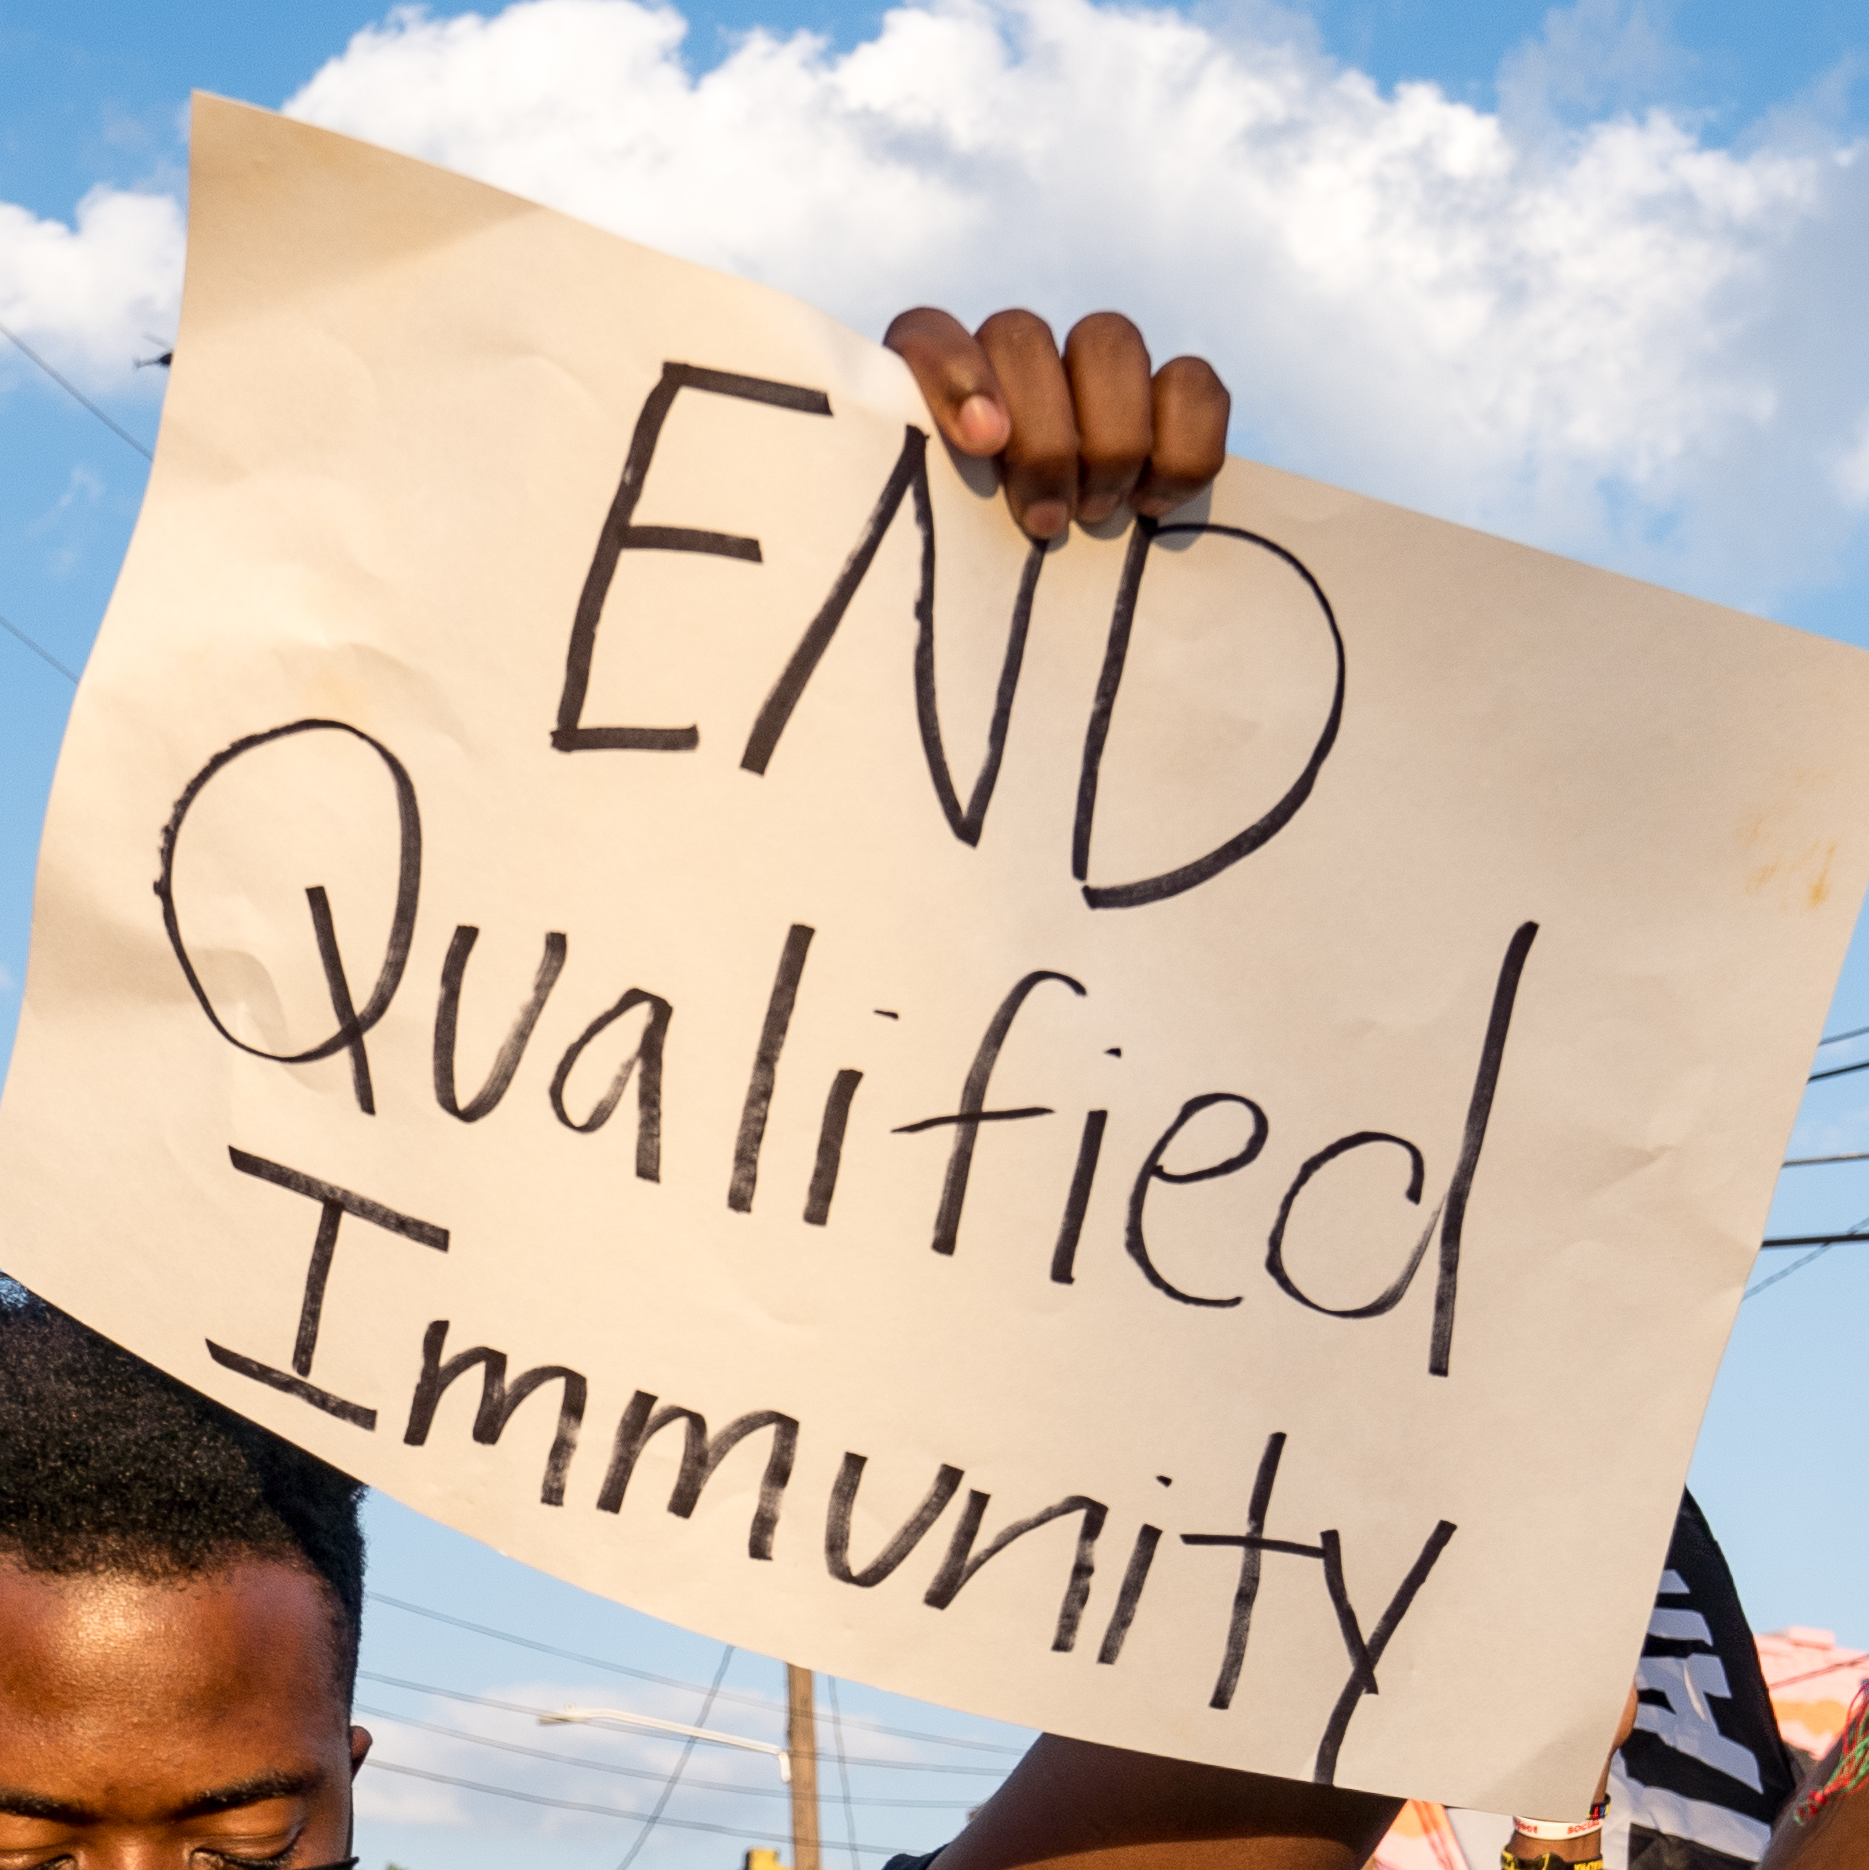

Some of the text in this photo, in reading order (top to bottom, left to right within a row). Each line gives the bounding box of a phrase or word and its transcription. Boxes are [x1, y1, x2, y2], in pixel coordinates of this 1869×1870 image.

[549, 360, 1346, 910] END
[153, 716, 1538, 1378] Qualified
[204, 1144, 1457, 1784] Immunity
